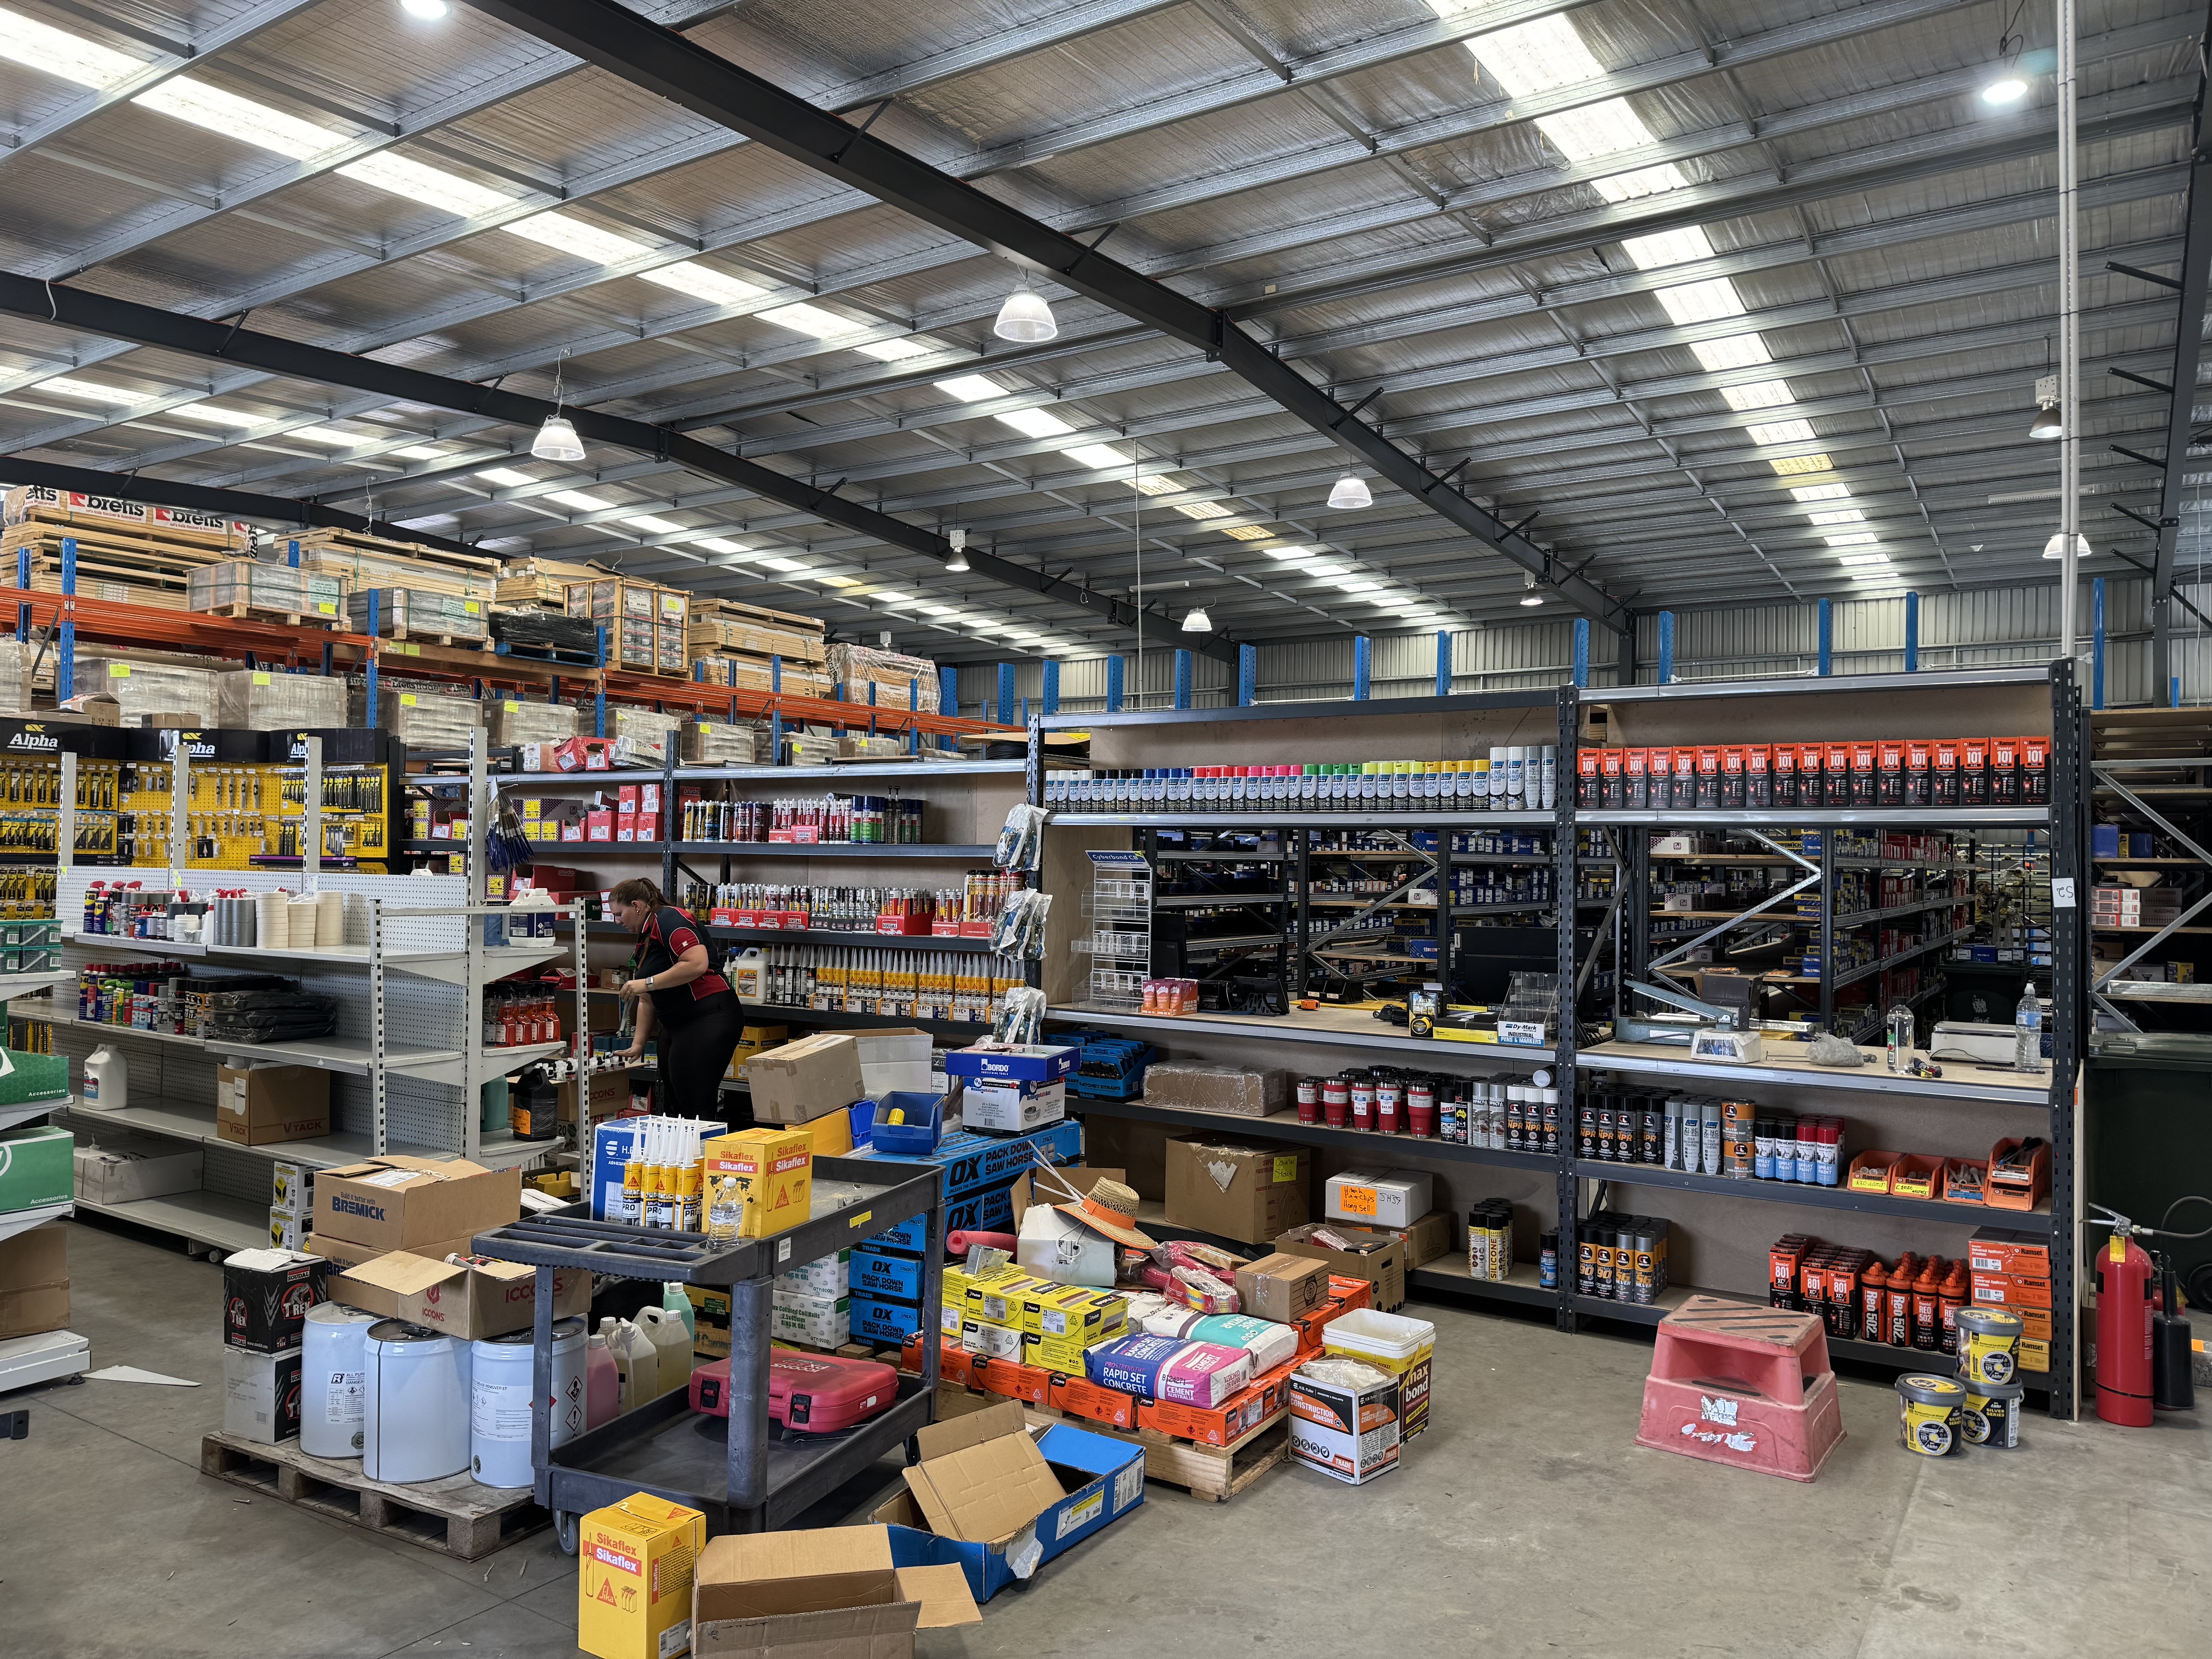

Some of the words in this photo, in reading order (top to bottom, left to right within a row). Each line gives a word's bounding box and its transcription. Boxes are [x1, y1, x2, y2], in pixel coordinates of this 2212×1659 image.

[8, 733, 58, 749] Alpha
[1778, 756, 1791, 767] 101
[1884, 754, 1898, 765] 101
[1967, 752, 1981, 763] 101
[2027, 750, 2042, 763] 101
[1583, 761, 1594, 771] 101
[988, 1063, 1008, 1072] BORDO
[1581, 1130, 1596, 1138] NPR
[1599, 1131, 1614, 1139] NPR
[1618, 1133, 1632, 1141] NPR
[720, 1151, 754, 1161] Sikaflex
[778, 1144, 807, 1157] Sikaflex
[986, 1147, 1009, 1163] PACK
[720, 1161, 753, 1171] Sikaflex
[776, 1156, 806, 1171] Sikaflex
[986, 1162, 1005, 1175] SAW
[1006, 1151, 1034, 1166] HORSE
[950, 1154, 983, 1187] OX
[1275, 1169, 1293, 1178] Stock
[30, 1194, 68, 1204] Accessories
[354, 1195, 366, 1203] better
[367, 1197, 376, 1205] with
[332, 1195, 386, 1221] BREMICK
[872, 1260, 893, 1274] OX
[1775, 1266, 1789, 1279] 801
[288, 1272, 310, 1281] SOUDAL
[862, 1273, 880, 1283] PACK
[881, 1278, 903, 1286] DOWN
[880, 1283, 903, 1292] HORSE
[1807, 1278, 1820, 1289] 801
[2024, 1279, 2045, 1287] Ramset
[1866, 1290, 1877, 1312] Reo
[422, 1307, 445, 1322] ICCONS
[1919, 1314, 1932, 1322] 502
[2024, 1311, 2045, 1319] Ramset
[1866, 1313, 1877, 1333] 502
[2021, 1341, 2043, 1350] Ramset
[1103, 1367, 1129, 1381] RAPID
[1130, 1372, 1147, 1384] SET
[1103, 1378, 1147, 1395] CONCRETE
[1167, 1386, 1194, 1397] CEMENT
[1406, 1379, 1429, 1403] bond
[1168, 1393, 1194, 1401] AUSTRALIA
[1290, 1392, 1304, 1401] TRADE
[1290, 1398, 1334, 1419] CONSTRUCTION
[1313, 1413, 1334, 1424] ADHESIVE
[1335, 1458, 1352, 1470] TRADE
[597, 1532, 637, 1556] Sikaflex
[597, 1547, 637, 1573] Sikaflex
